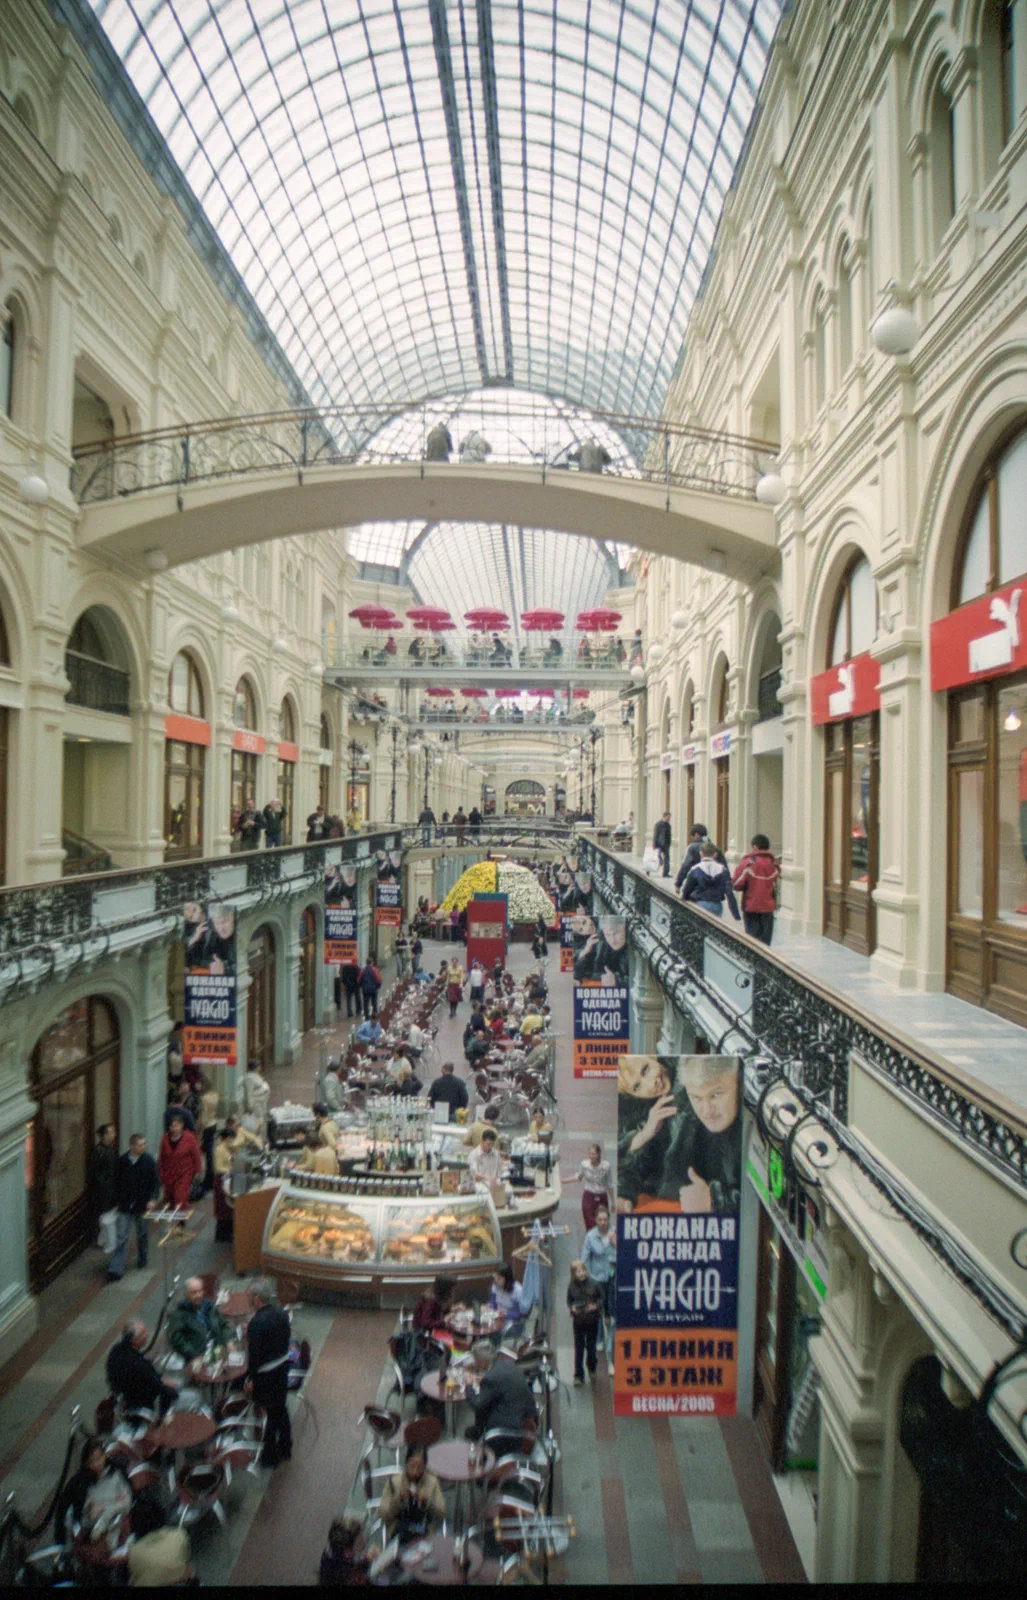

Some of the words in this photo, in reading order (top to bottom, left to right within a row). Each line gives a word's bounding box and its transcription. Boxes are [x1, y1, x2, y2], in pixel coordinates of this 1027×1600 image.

[576, 988, 627, 999] КОЖАНАЯ
[190, 999, 230, 1020] IVAGIO
[582, 999, 621, 1009] ОДЕЖДА
[581, 1011, 621, 1031] IVAGIO
[577, 1043, 582, 1053] 1
[585, 1043, 628, 1053] ЛИНИЯ
[580, 1056, 587, 1066] 3
[624, 1217, 736, 1240] КОЖАНАЯ
[637, 1241, 722, 1263] ОДЕЖДА
[634, 1267, 720, 1311] IVAGIO
[620, 1340, 632, 1360] 1
[638, 1339, 734, 1361] ЛИНИЯ
[626, 1367, 642, 1387] 3
[649, 1367, 723, 1387] ЭТАЖ
